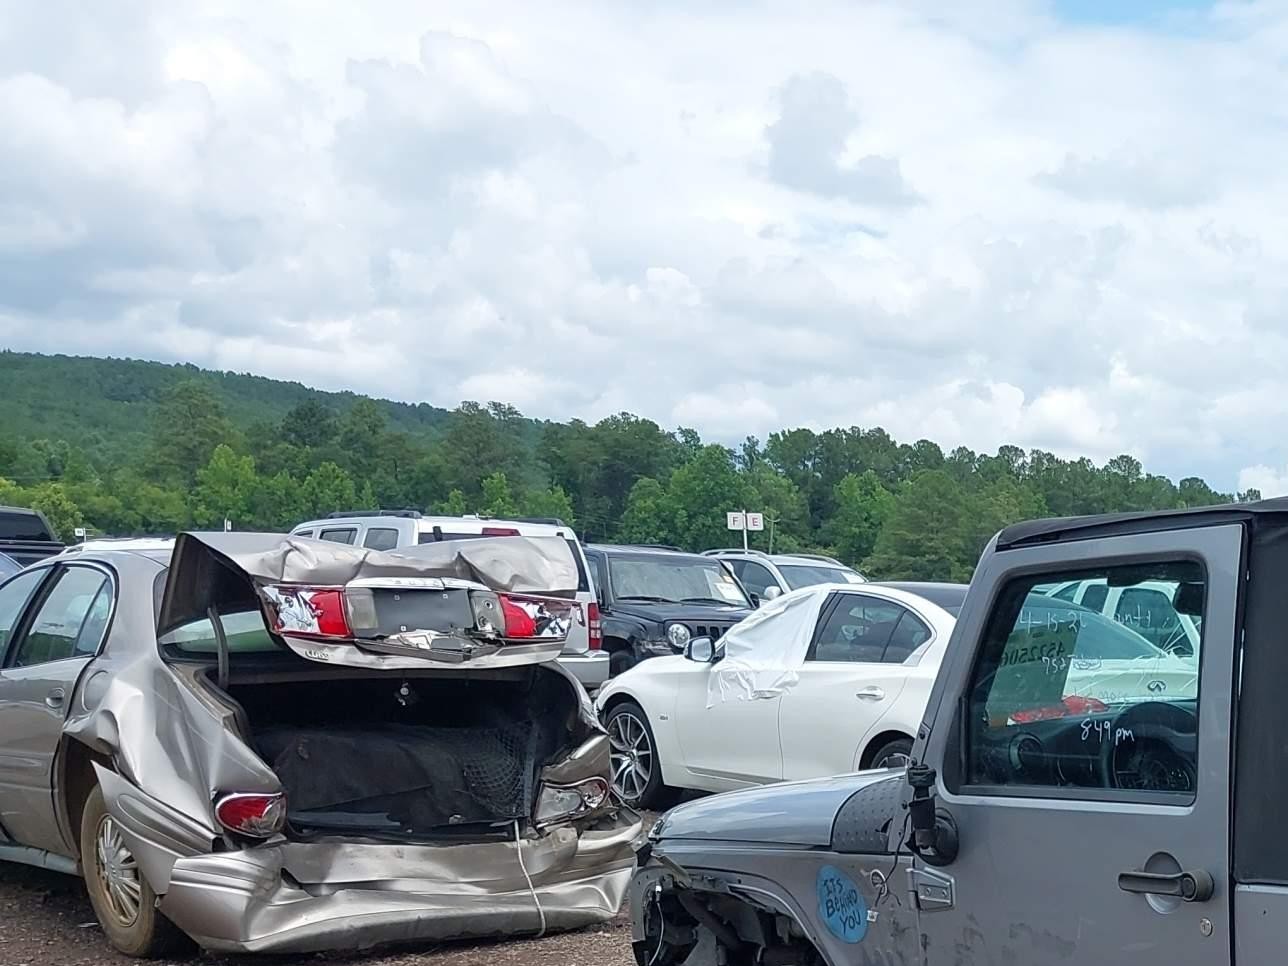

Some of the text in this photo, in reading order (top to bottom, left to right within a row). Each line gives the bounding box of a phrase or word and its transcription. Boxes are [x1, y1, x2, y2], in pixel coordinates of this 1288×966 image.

[732, 516, 739, 527] F
[752, 517, 759, 527] E
[1080, 718, 1135, 746] 849 pm
[839, 910, 861, 936] YOU
